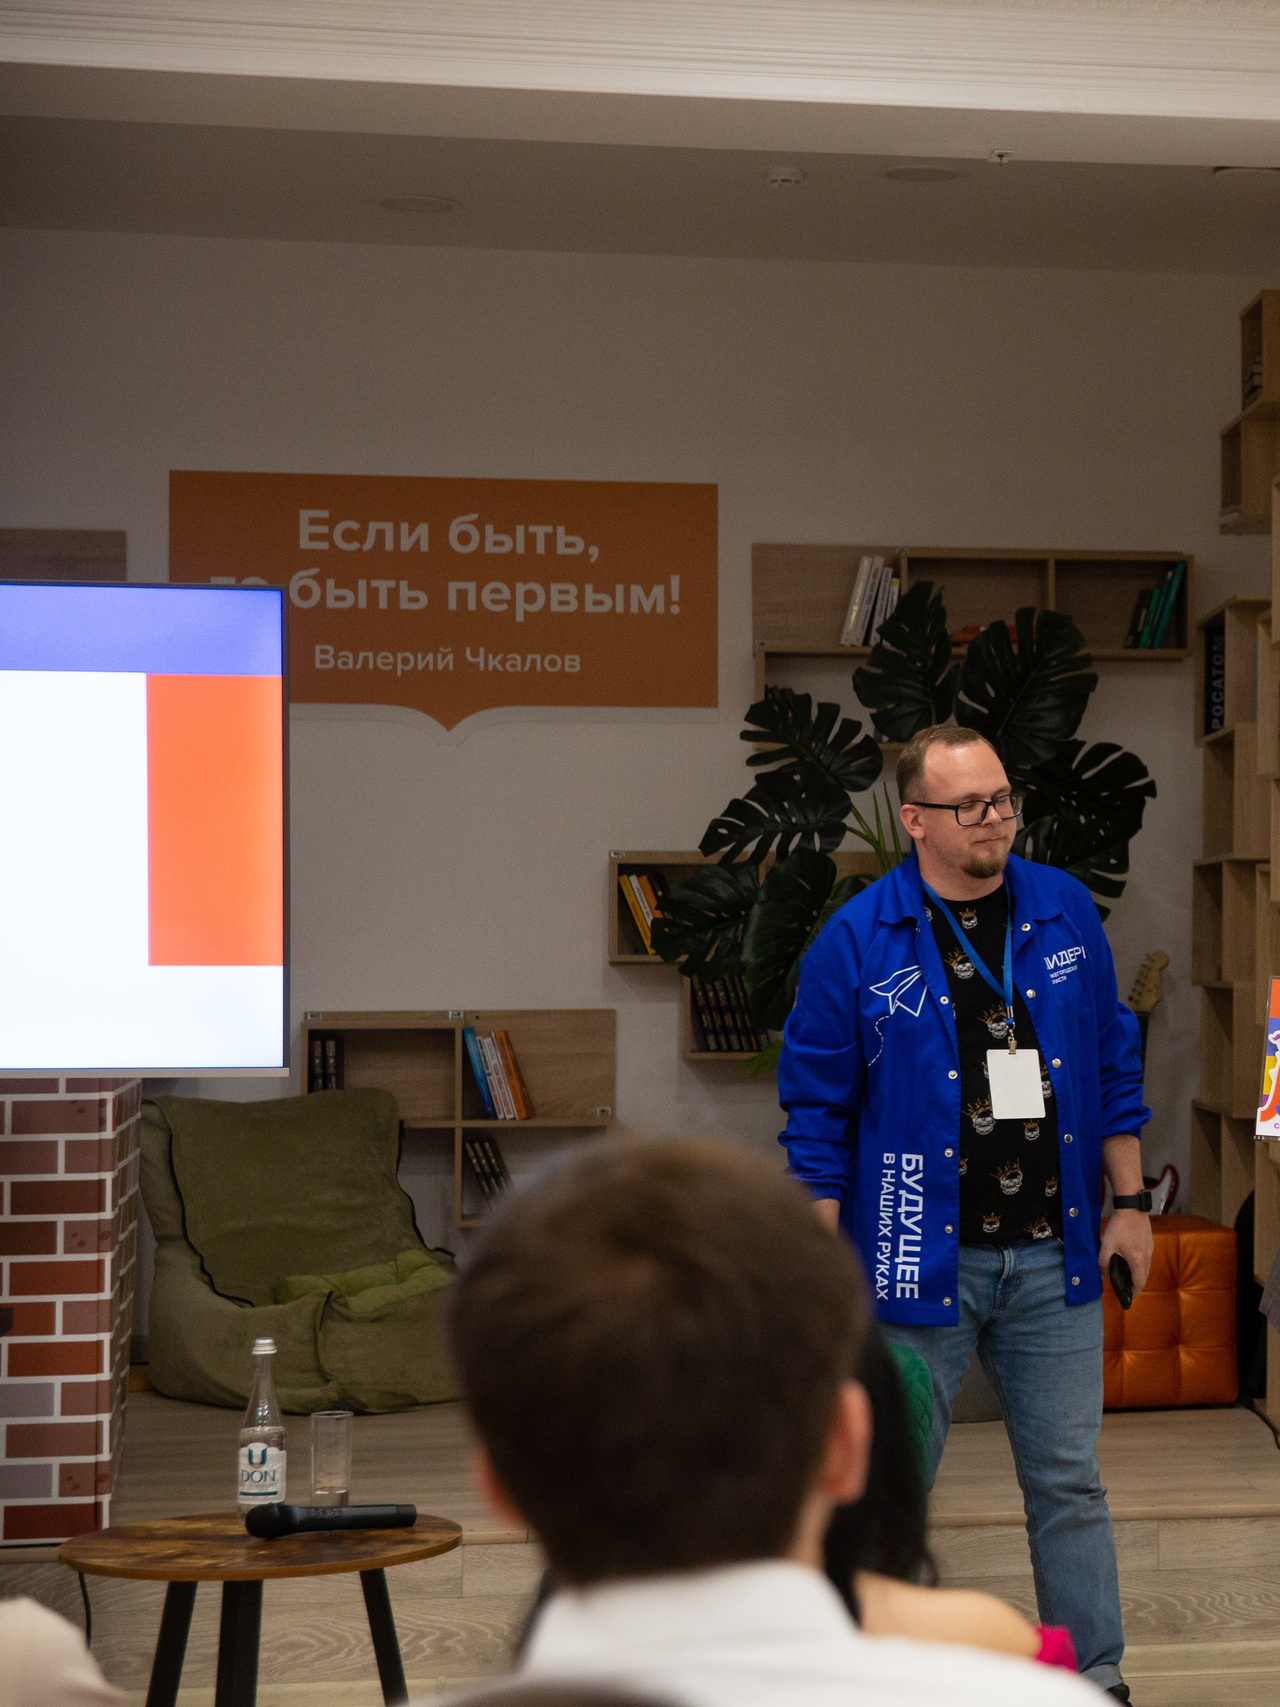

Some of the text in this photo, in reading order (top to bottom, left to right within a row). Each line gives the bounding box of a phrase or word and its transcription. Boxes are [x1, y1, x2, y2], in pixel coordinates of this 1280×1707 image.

[299, 509, 600, 563] Если быть,
[289, 568, 681, 623] быть первым!
[314, 644, 581, 676] Валерий Чкалов
[875, 1152, 896, 1300] В НАШИХ РУКАХ
[894, 1153, 924, 1299] БУДУЩЕЕ
[241, 1469, 276, 1483] DON
